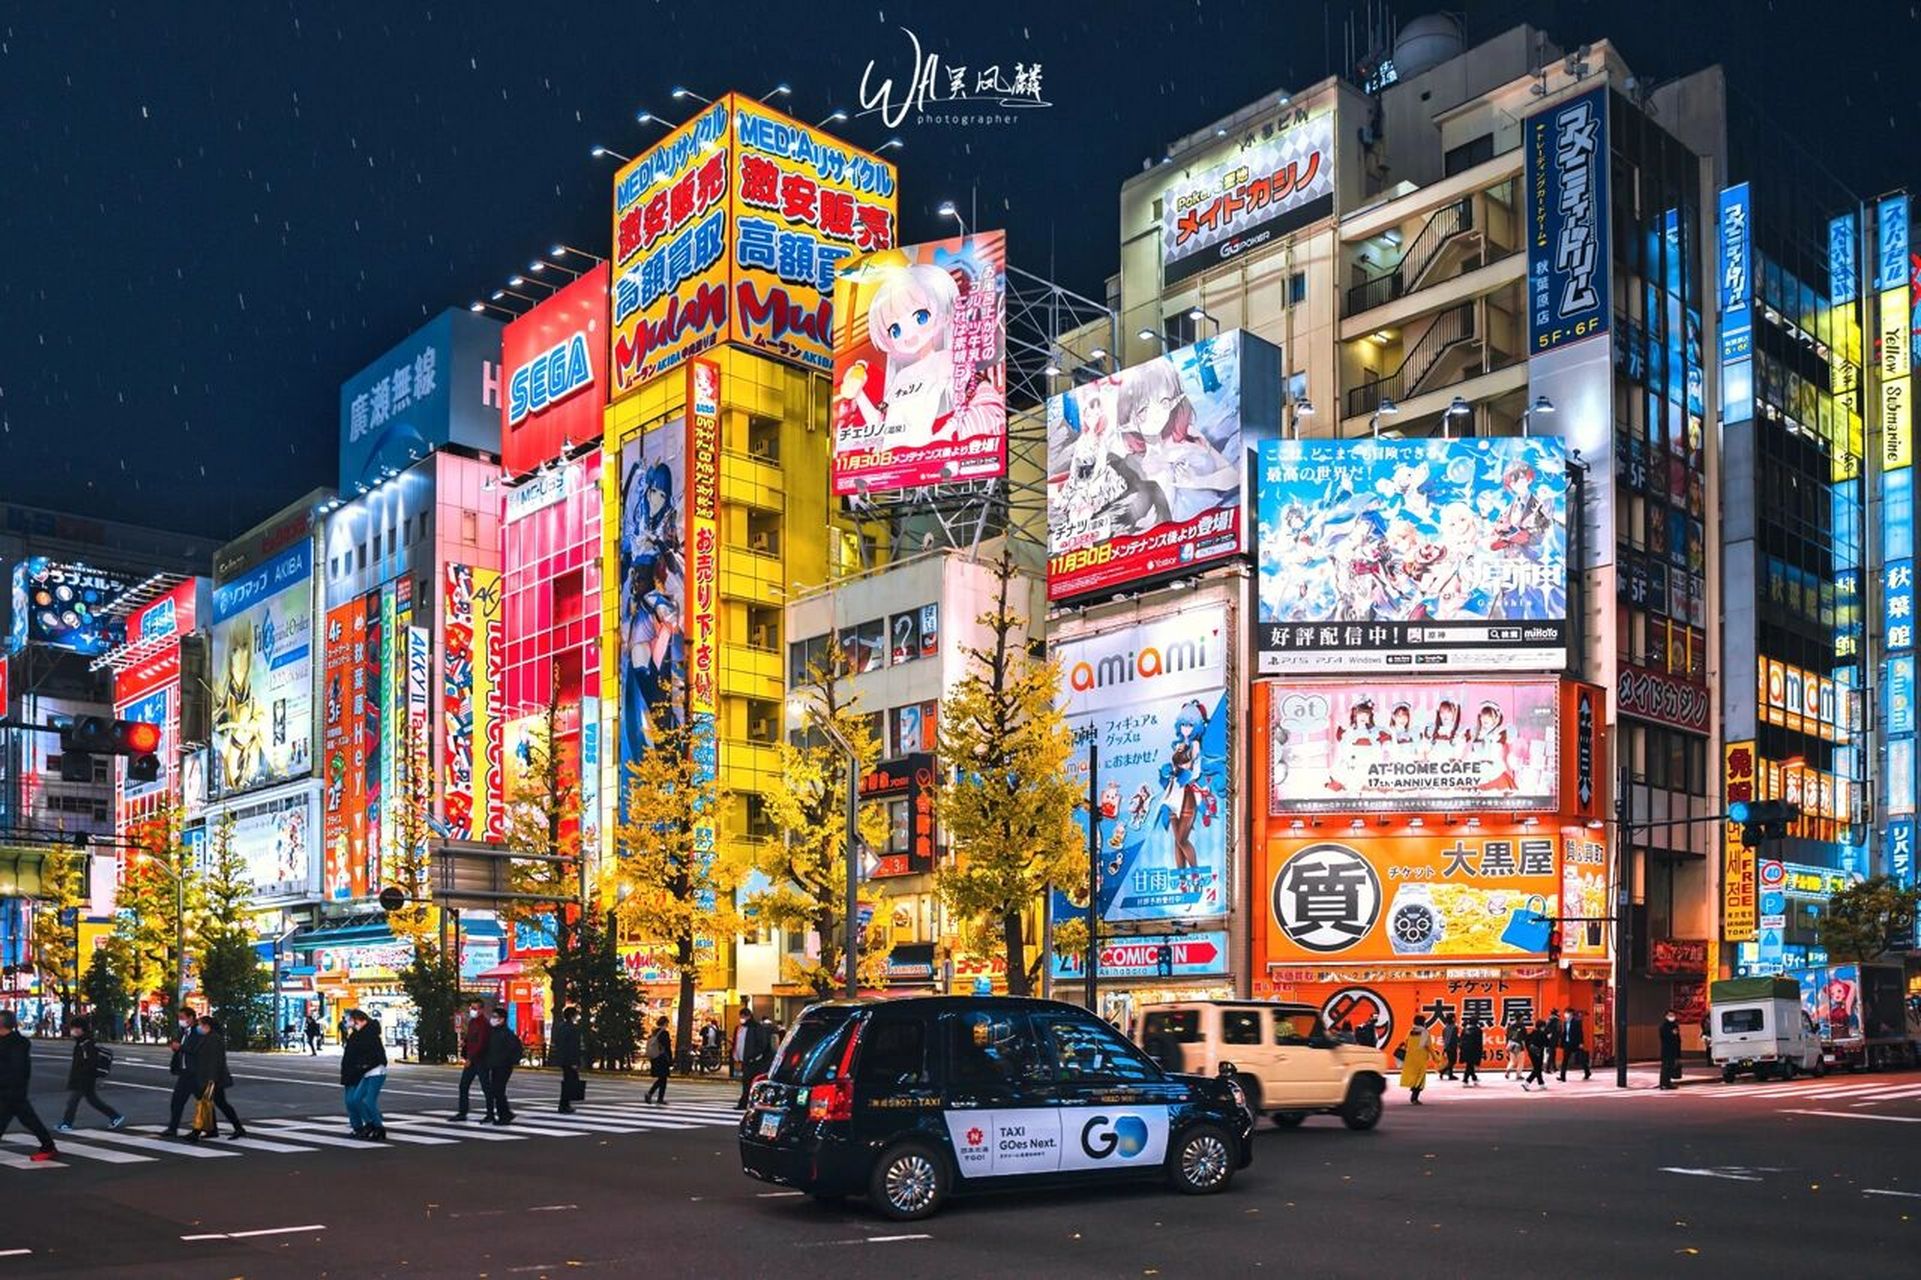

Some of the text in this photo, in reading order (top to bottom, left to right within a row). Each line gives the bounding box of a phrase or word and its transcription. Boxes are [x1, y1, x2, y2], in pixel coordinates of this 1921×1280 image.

[617, 150, 726, 266] 激安販売
[738, 152, 893, 252] 激安販売
[1176, 151, 1322, 246] メイドカジノ
[736, 216, 852, 293] 高額買
[614, 209, 725, 326] 高額買取
[736, 280, 833, 350] Mul
[614, 281, 728, 388] Mulan
[509, 332, 594, 426] SEGA
[1885, 327, 1902, 462] Yellow Submarine
[840, 423, 885, 442] チェリノ
[1265, 464, 1374, 483] 最高の世界だ!
[1054, 519, 1089, 541] チナツ
[50, 569, 125, 592] ラブメルシ
[274, 553, 303, 584] AKIBA
[1887, 566, 1911, 648] 秋葉館
[328, 619, 342, 643] 4F
[1270, 625, 1399, 647] 好評配信中!
[411, 631, 428, 692] AKKY
[1071, 635, 1206, 692] amiami
[1349, 656, 1382, 665] Windows
[1293, 700, 1318, 718] at
[1617, 668, 1709, 727] メイドカジノ
[328, 699, 342, 724] 3F
[1105, 714, 1158, 733] フィギュア&
[1105, 732, 1141, 746] グッズは
[1104, 749, 1158, 769] におまかせ!
[1441, 762, 1481, 775] CAFE
[1394, 777, 1481, 788] ANNIVERSARY
[327, 786, 342, 813] 2F
[1388, 839, 1553, 880] チケット 大黒屋
[1133, 869, 1168, 893] 甘雨
[1742, 858, 1753, 907] FREE
[1286, 861, 1368, 938] 質
[1765, 898, 1777, 913] P
[1101, 946, 1159, 967] COMIC
[1448, 980, 1509, 993] チケット
[1422, 998, 1535, 1030] 大黒屋
[918, 1097, 941, 1106] TAXI
[1000, 1126, 1025, 1137] TAXI
[1000, 1138, 1057, 1150] GOes Next.
